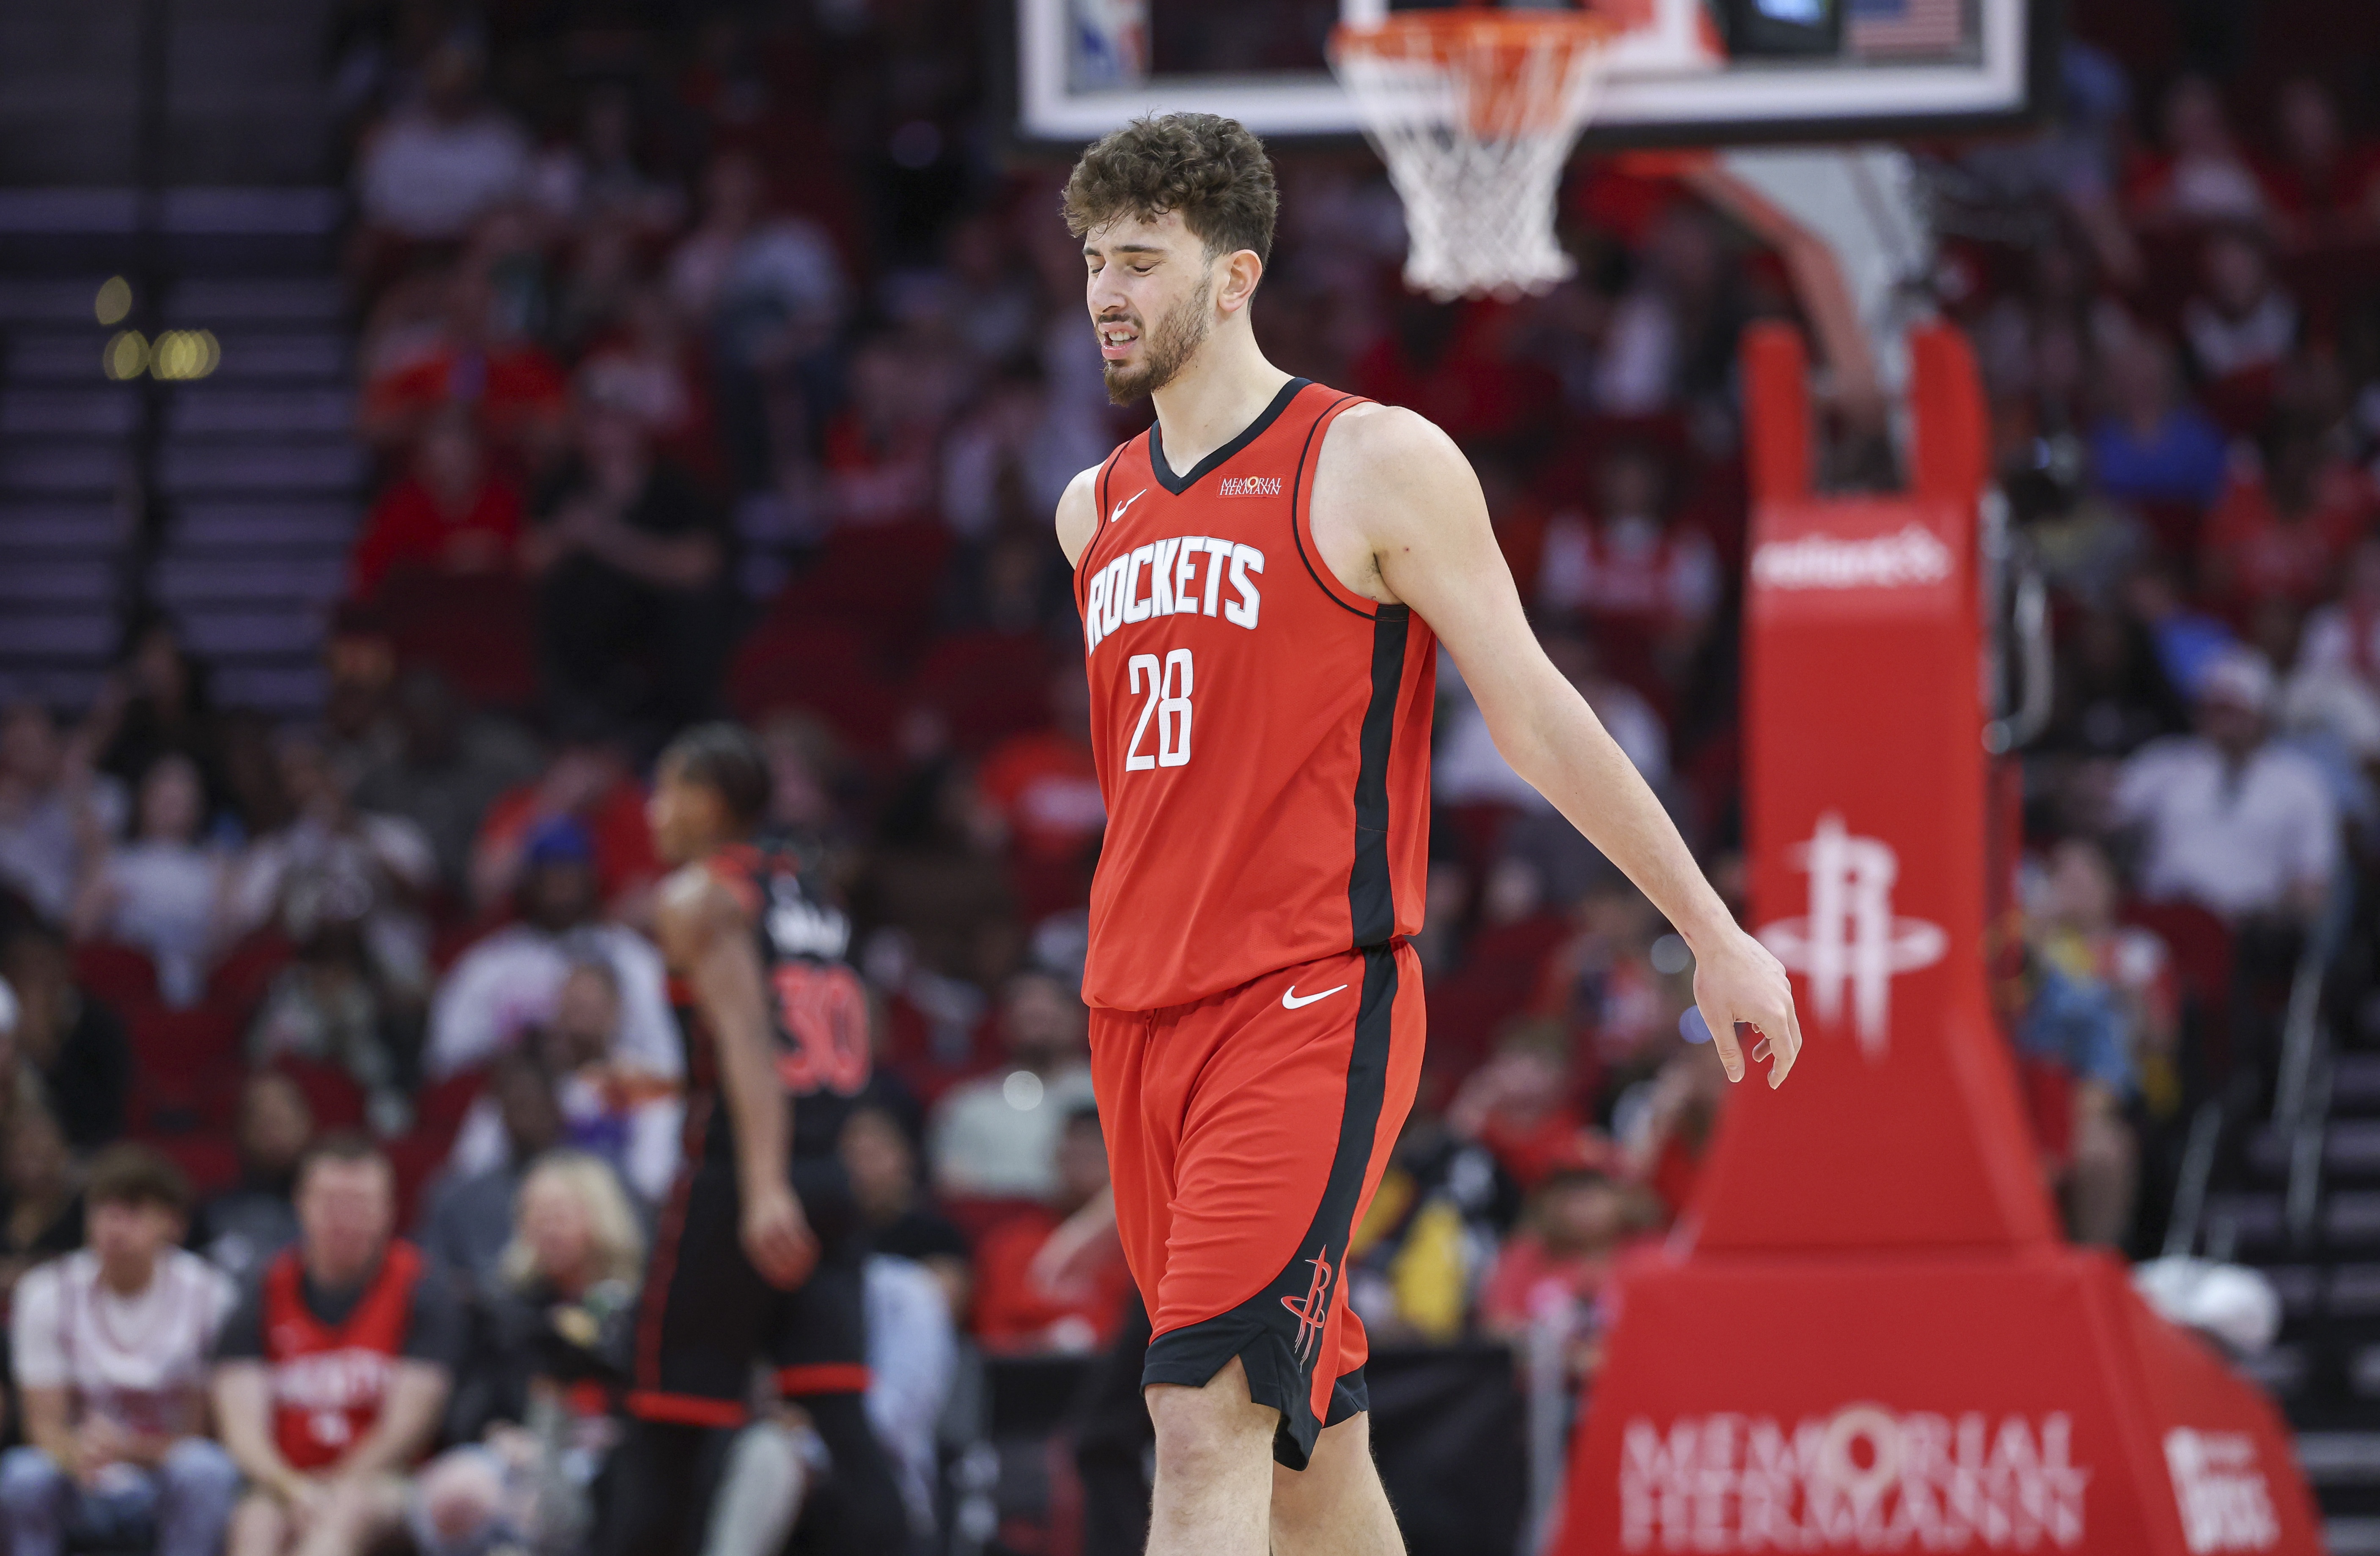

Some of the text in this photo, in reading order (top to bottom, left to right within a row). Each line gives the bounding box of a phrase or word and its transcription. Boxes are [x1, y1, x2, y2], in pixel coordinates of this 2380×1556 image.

[1219, 486, 1281, 496] HERMANN
[1222, 476, 1282, 488] MEMORIAL
[1085, 536, 1265, 657] ROCKETS
[1125, 648, 1194, 773] 28
